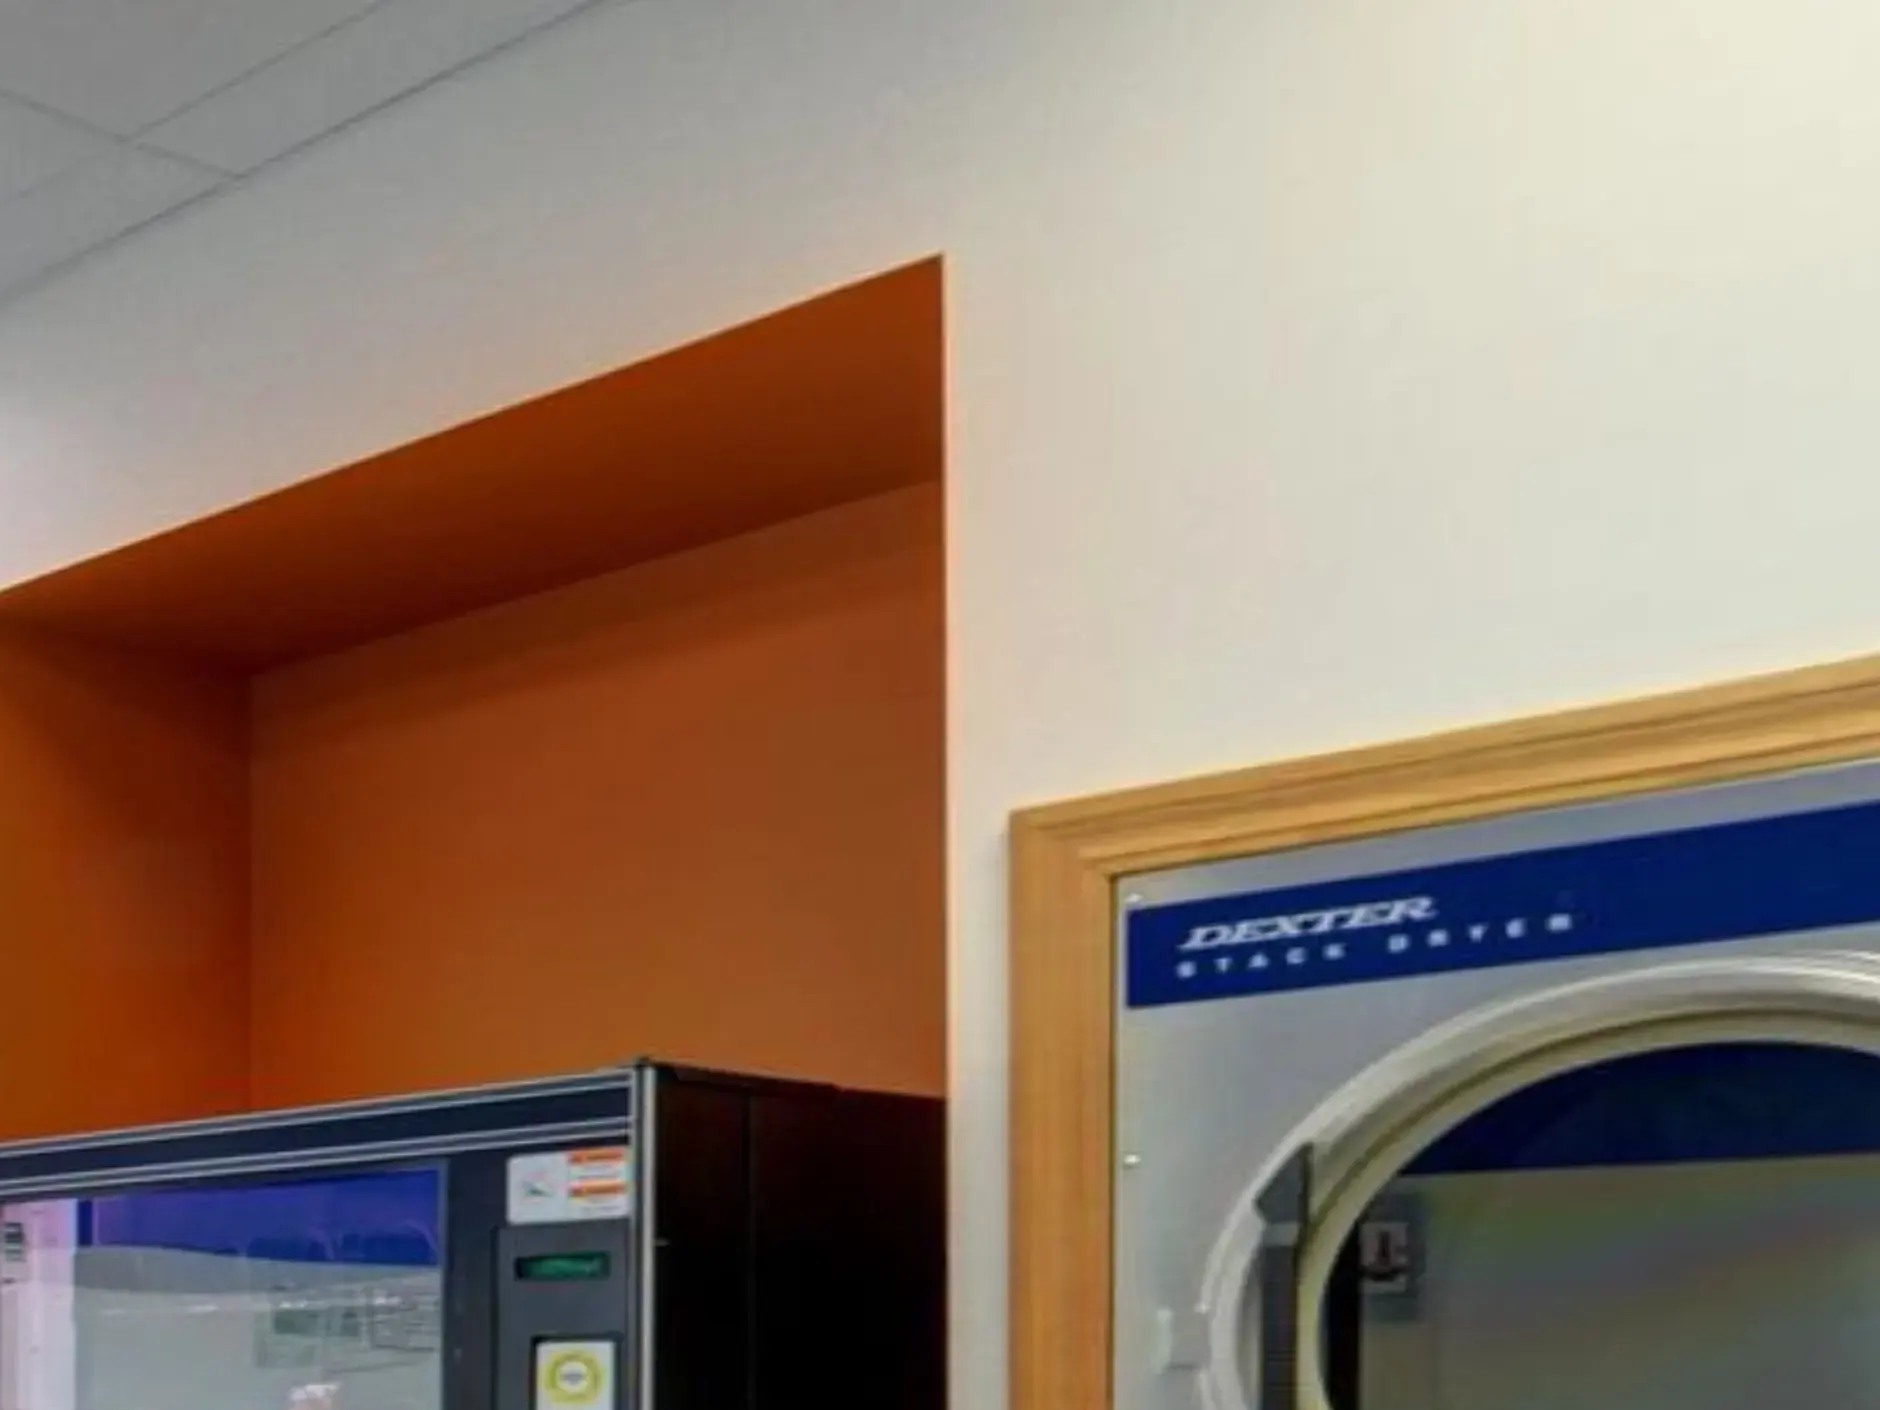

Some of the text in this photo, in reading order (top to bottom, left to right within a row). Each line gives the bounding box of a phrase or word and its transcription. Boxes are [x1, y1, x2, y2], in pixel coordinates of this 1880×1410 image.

[1176, 912, 1573, 979] STACK DRYER
[1178, 896, 1437, 951] DEXTER
